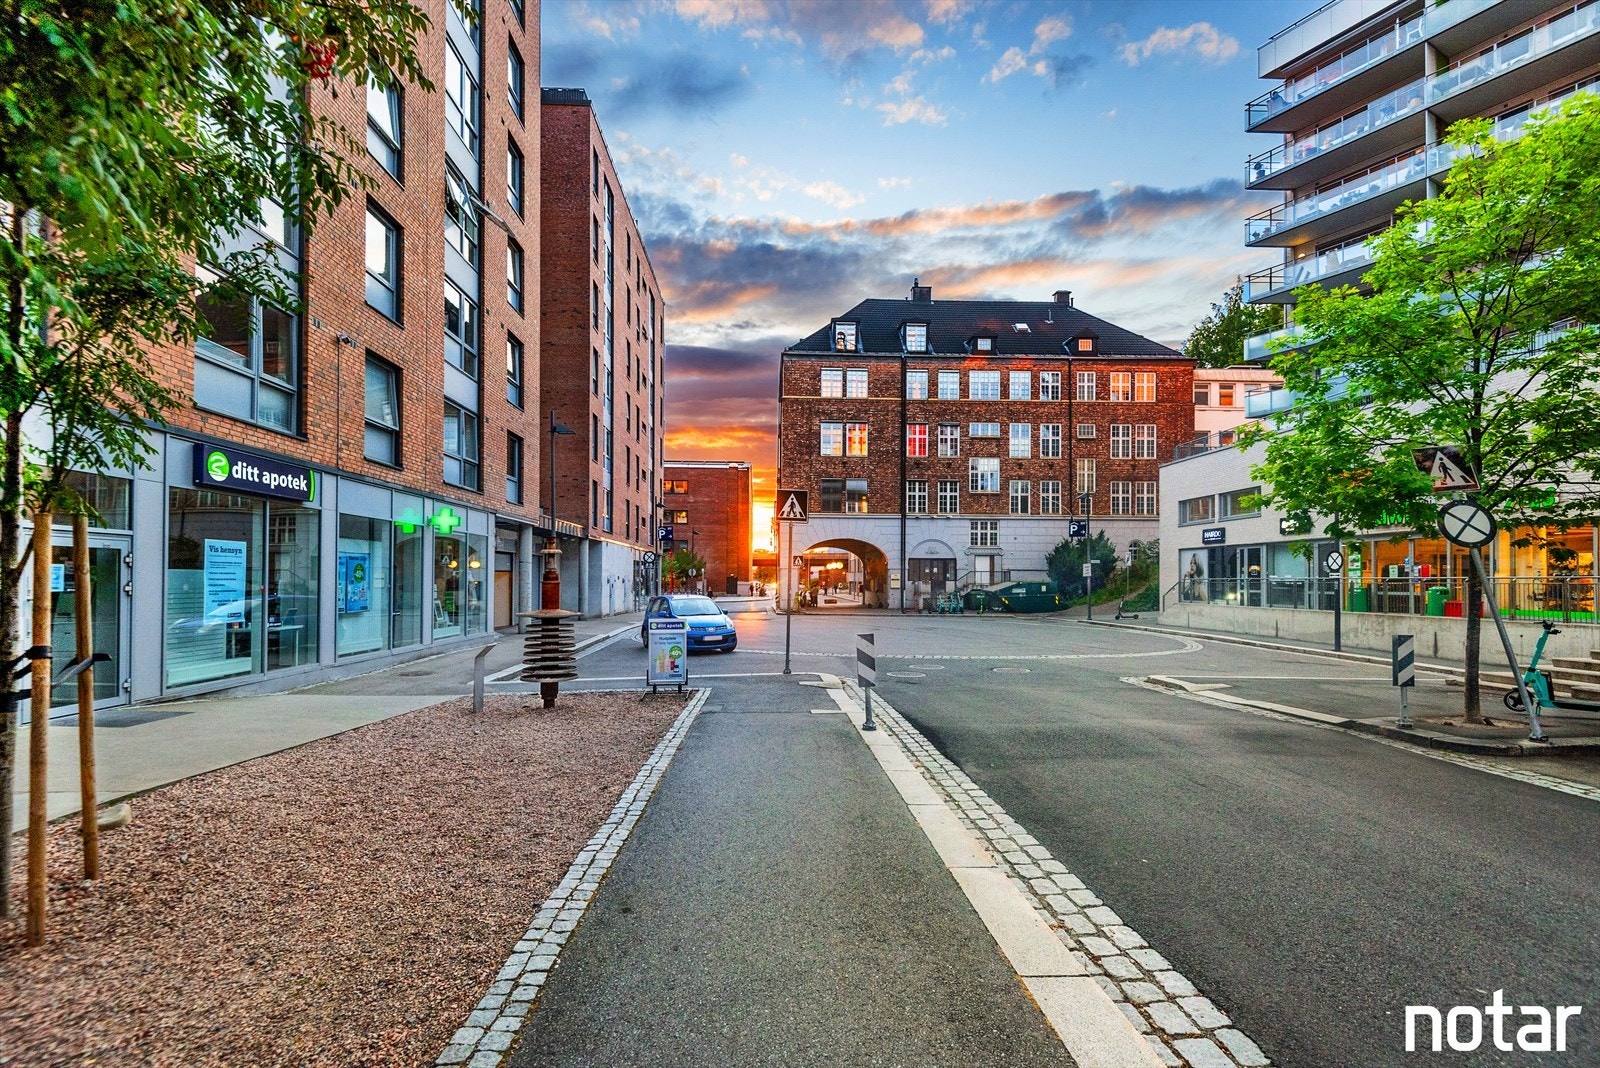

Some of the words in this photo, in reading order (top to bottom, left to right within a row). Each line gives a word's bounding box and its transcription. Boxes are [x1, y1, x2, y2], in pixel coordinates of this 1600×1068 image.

[231, 461, 259, 482] ditt
[262, 471, 308, 491] apotek
[658, 529, 666, 539] P
[1070, 524, 1078, 535] P
[208, 544, 219, 553] Vis
[220, 545, 243, 555] hensyn
[667, 622, 683, 630] apotek
